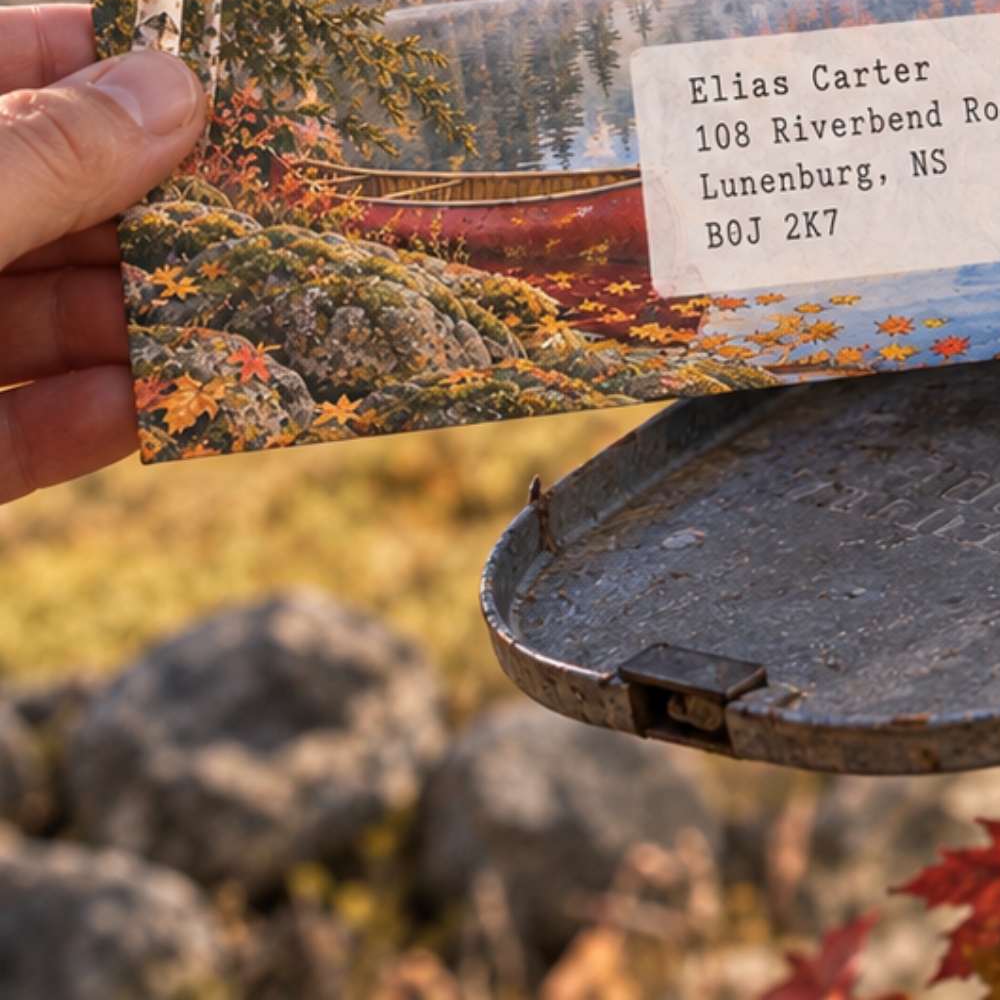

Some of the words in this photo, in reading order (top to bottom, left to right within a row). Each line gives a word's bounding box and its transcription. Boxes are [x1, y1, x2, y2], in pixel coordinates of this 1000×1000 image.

[689, 72, 790, 104] Elias
[811, 58, 931, 92] Carter
[696, 121, 751, 151] 108
[772, 101, 943, 144] Riverbend
[700, 161, 888, 199] Lunenburg,
[910, 148, 948, 177] NS
[784, 209, 839, 241] 2K7
